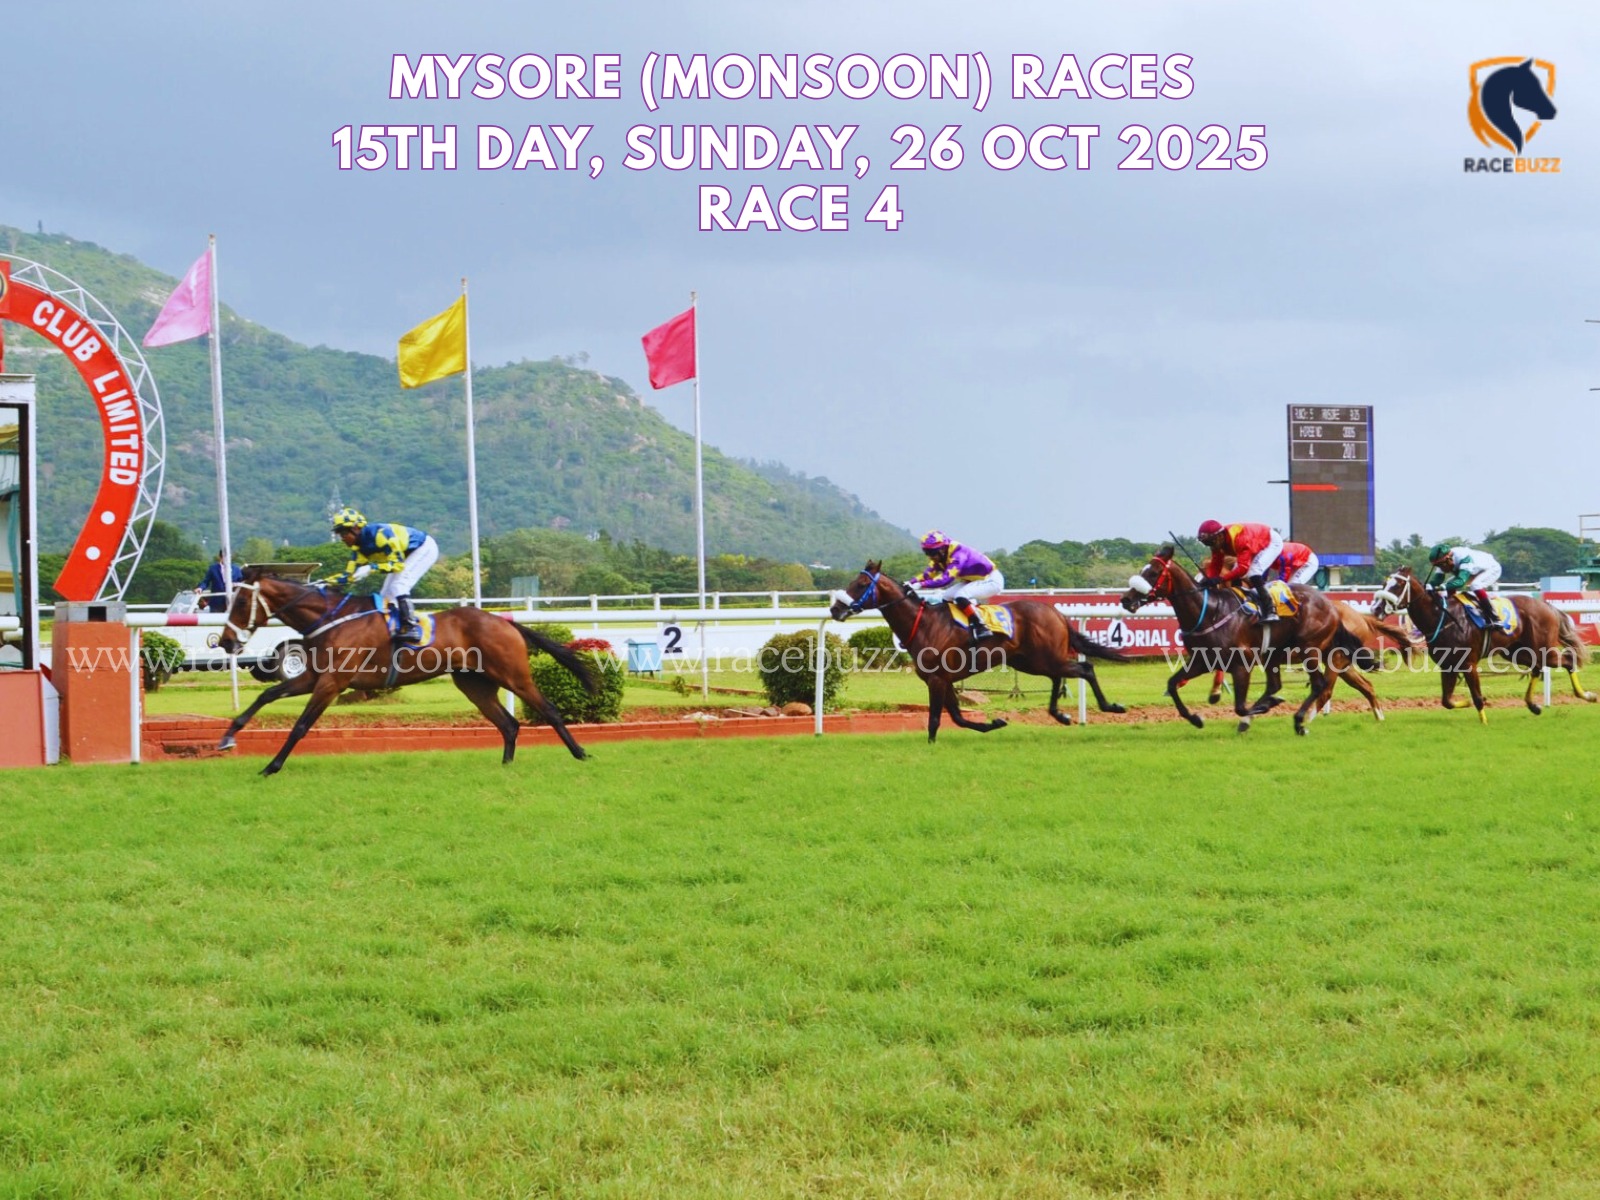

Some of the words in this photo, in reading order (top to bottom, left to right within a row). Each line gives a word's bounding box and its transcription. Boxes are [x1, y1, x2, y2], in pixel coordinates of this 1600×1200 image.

[32, 300, 101, 362] CLUB
[93, 370, 139, 486] LIMITED
[663, 626, 683, 654] 2
[1085, 629, 1170, 647] MEORIAL
[1111, 622, 1123, 647] 4
